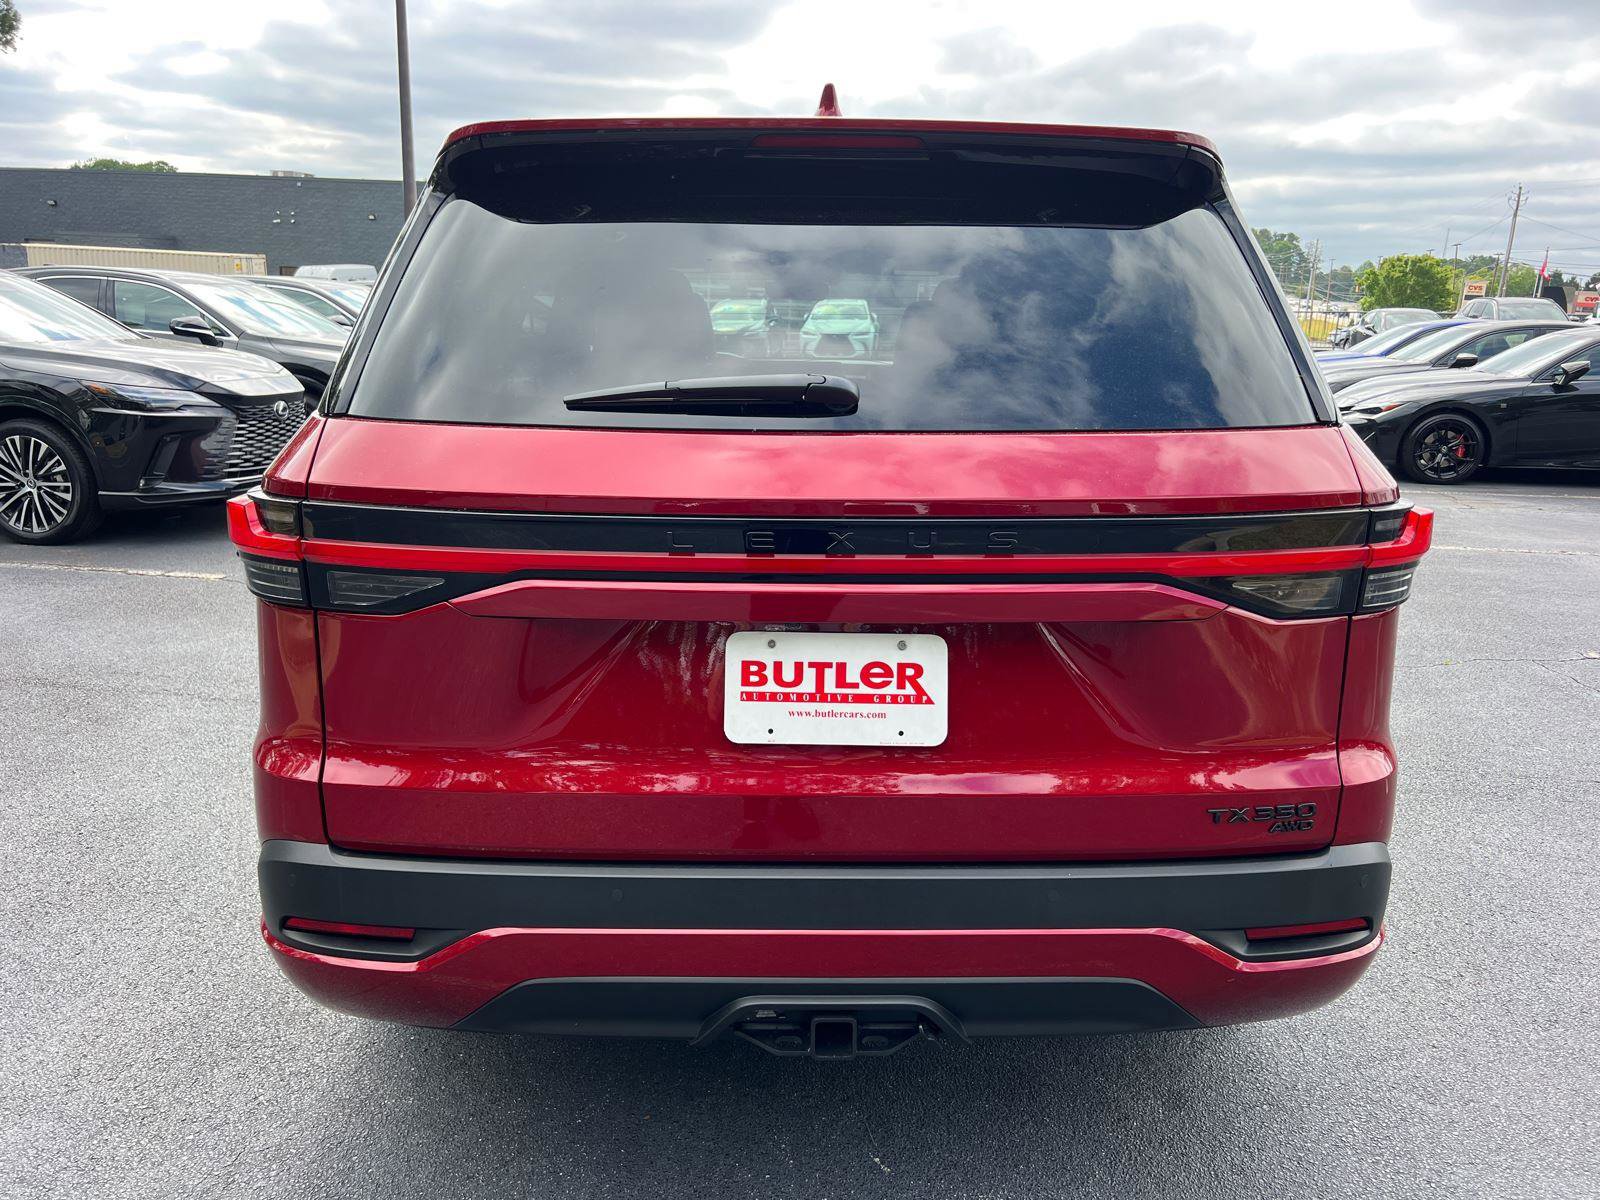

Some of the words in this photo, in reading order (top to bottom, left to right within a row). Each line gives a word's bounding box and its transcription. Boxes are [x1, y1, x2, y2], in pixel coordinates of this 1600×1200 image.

[666, 530, 1019, 551] LEXUS
[741, 692, 854, 702] AUTOMOTIVE
[873, 694, 929, 704] GROUP
[788, 709, 887, 720] www.butlercars.com
[1269, 819, 1315, 834] AWD
